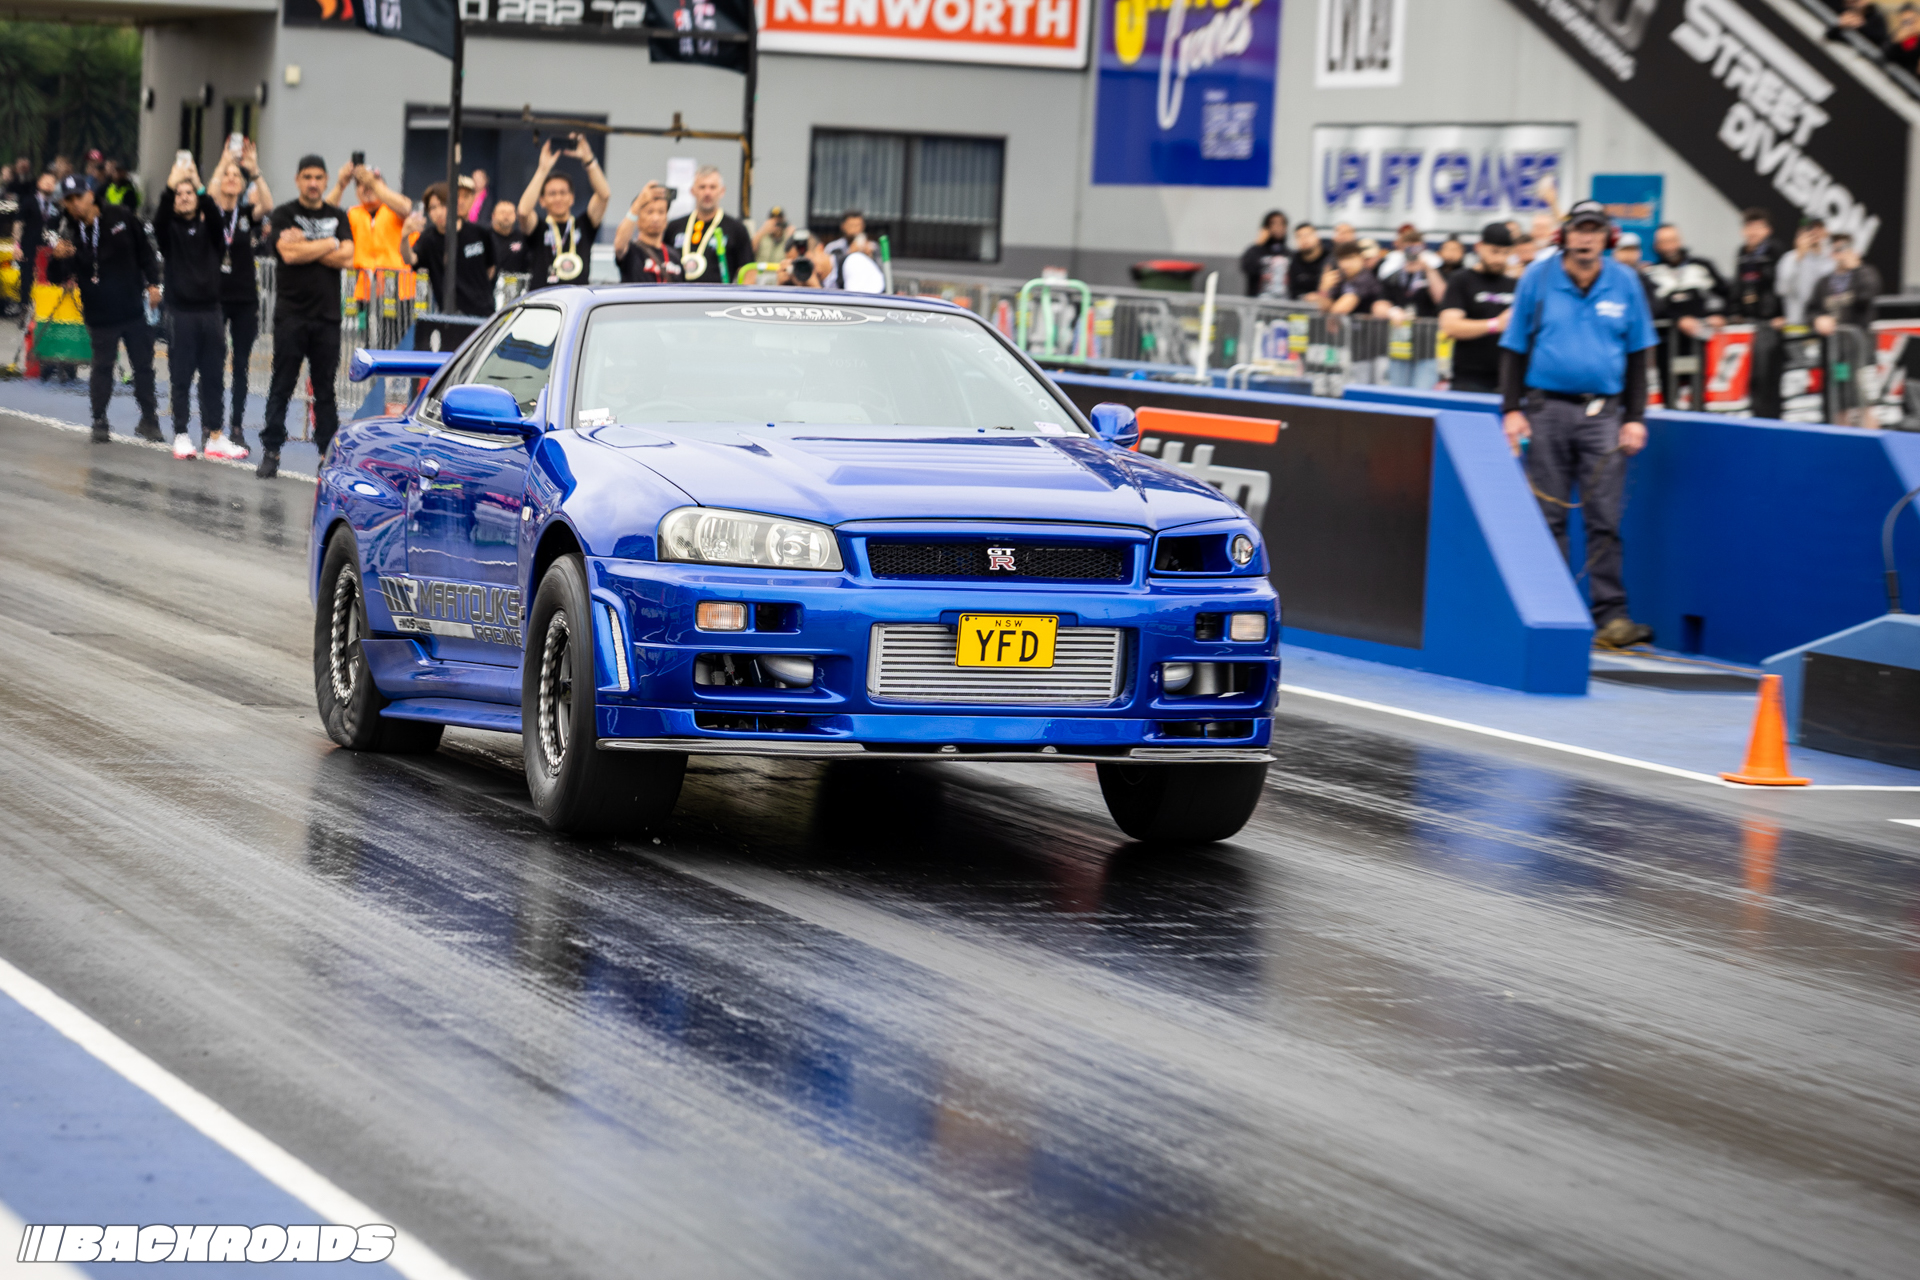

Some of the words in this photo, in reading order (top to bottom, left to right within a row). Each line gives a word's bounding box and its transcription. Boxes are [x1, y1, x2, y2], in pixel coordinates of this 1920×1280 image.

[773, 0, 1071, 37] KENWORTH
[1668, 0, 1833, 147] STREET
[1323, 151, 1424, 209] UPLIFT
[1717, 102, 1881, 255] DIVISION
[740, 307, 844, 319] CUSTOM
[987, 548, 1016, 556] GT
[419, 579, 521, 627] MAATOUKS
[473, 623, 523, 648] RACING
[995, 619, 1023, 628] NSW
[976, 629, 1039, 662] YFD
